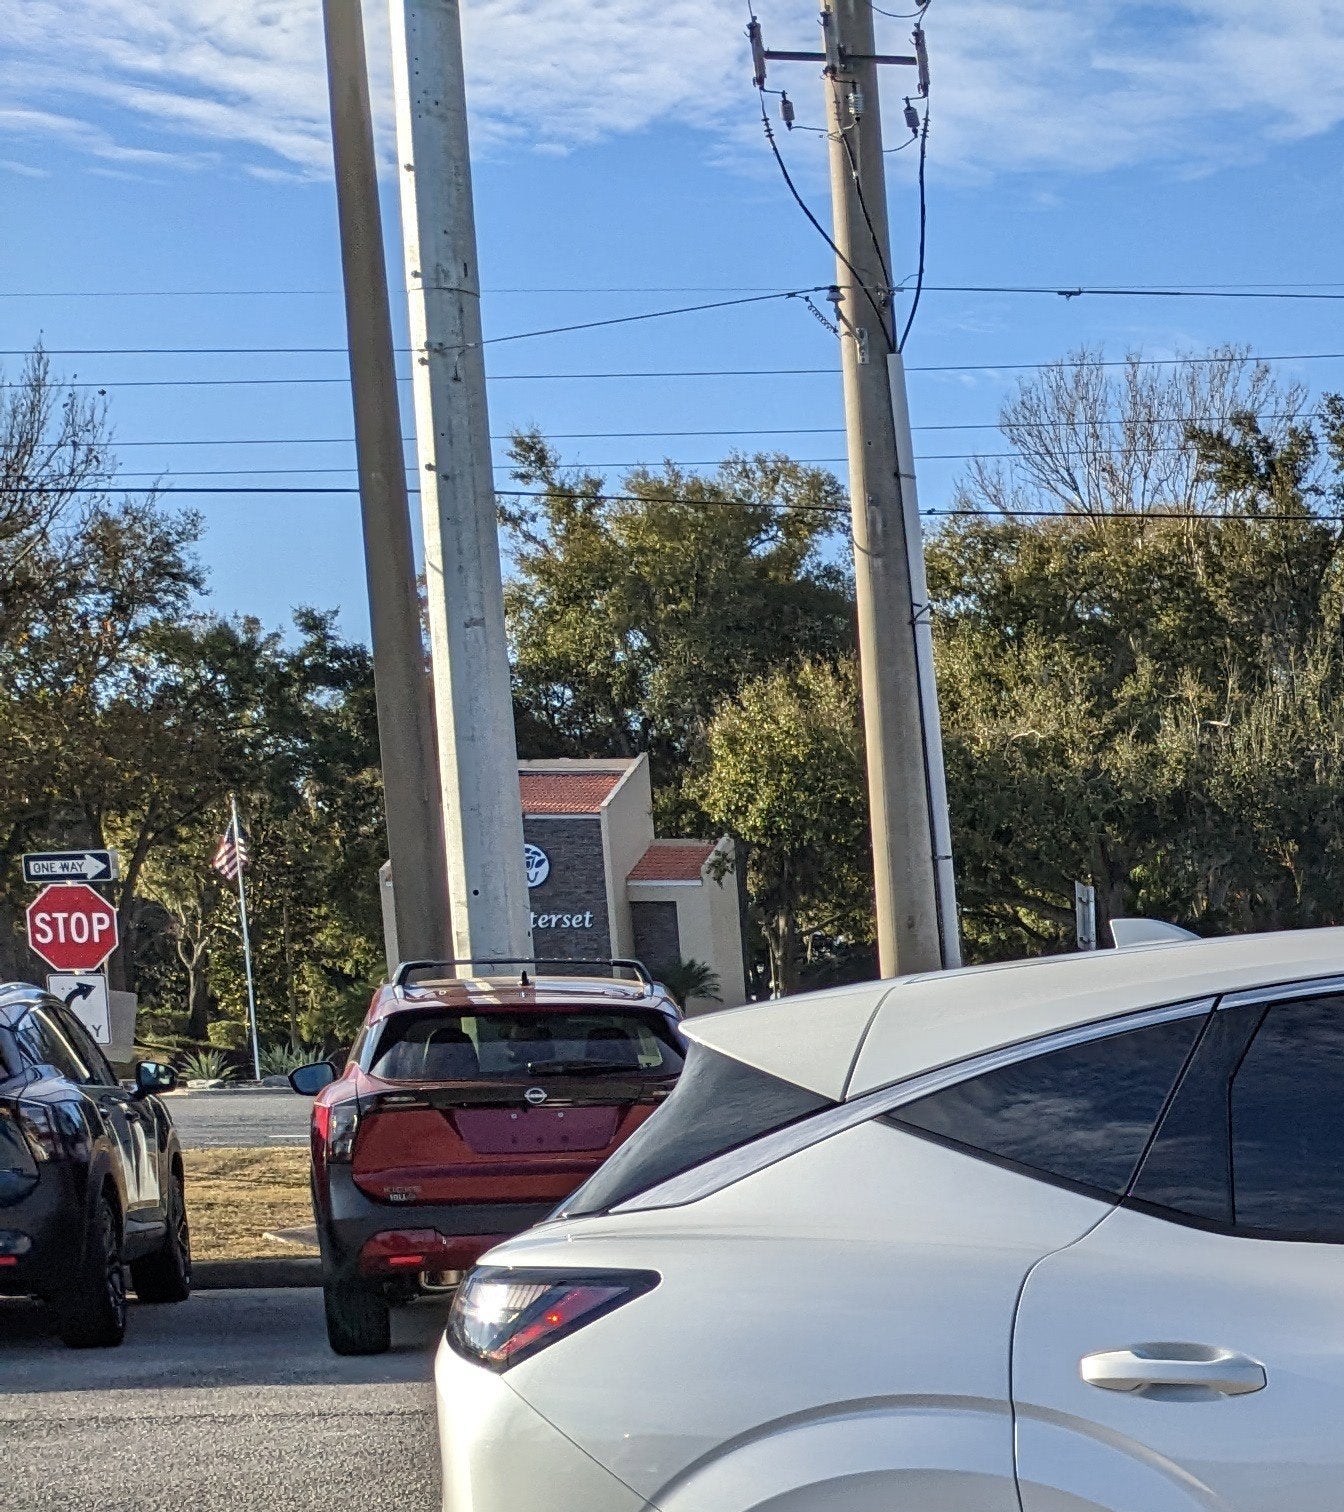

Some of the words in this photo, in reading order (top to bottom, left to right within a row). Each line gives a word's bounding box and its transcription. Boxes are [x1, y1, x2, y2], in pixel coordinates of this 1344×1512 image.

[33, 862, 58, 874] ONE
[59, 861, 85, 874] WAY
[34, 911, 110, 944] STOP
